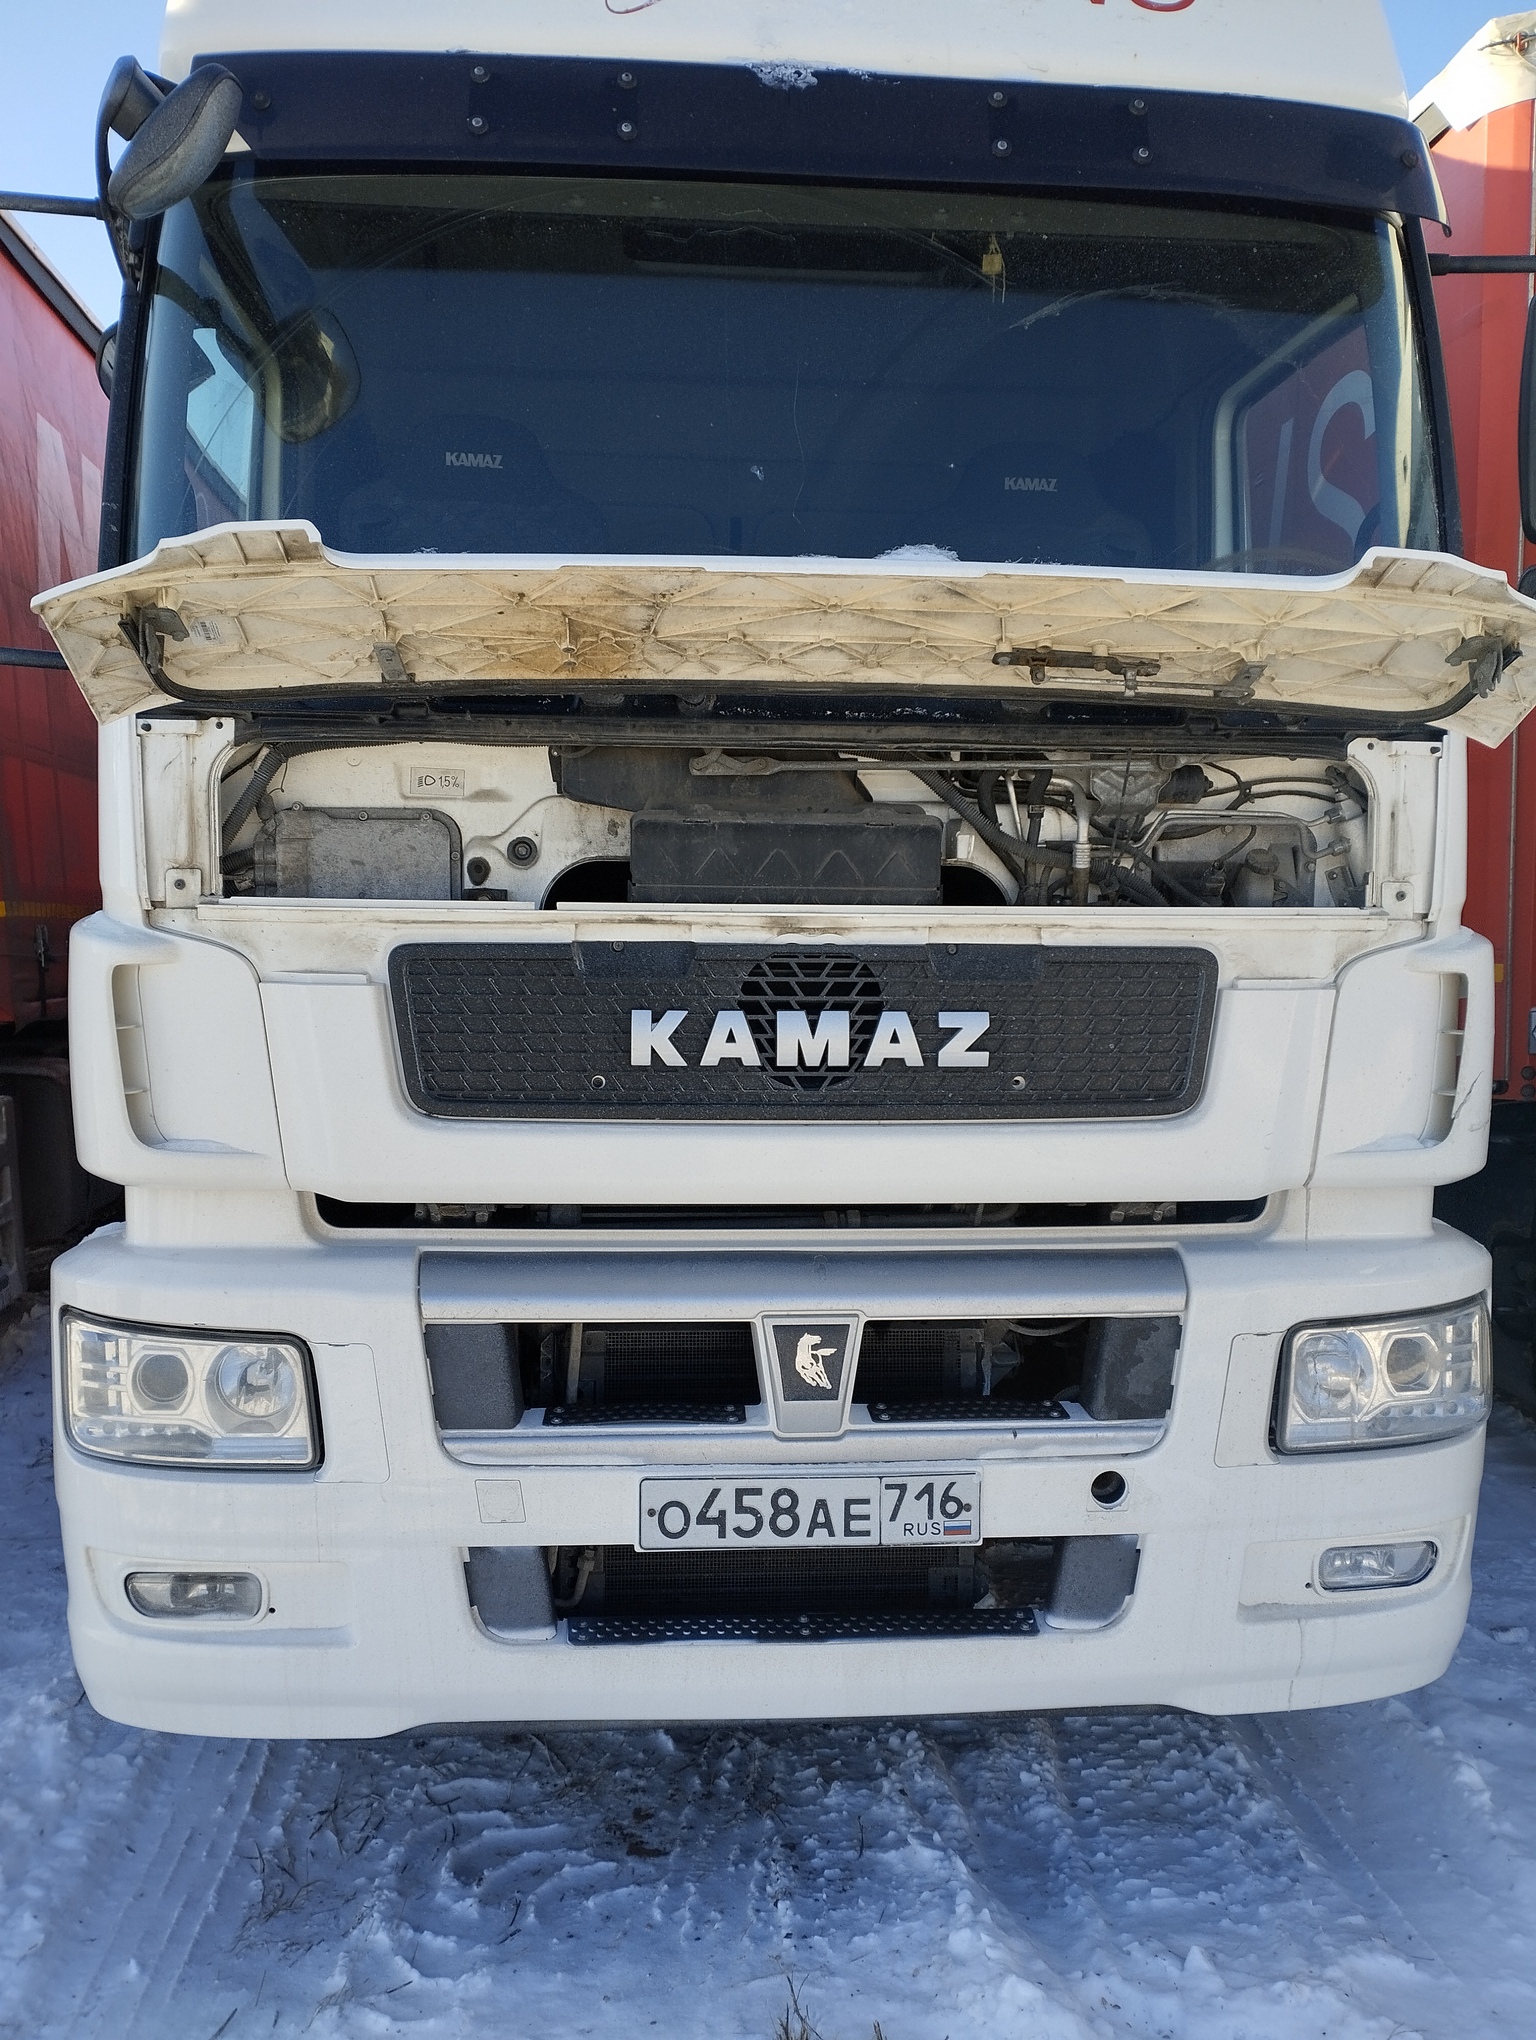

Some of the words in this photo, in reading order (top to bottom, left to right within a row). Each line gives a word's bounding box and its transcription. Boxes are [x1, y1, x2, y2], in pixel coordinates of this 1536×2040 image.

[445, 451, 504, 469] KAMAZ
[1004, 476, 1058, 492] KAMAZ
[630, 1009, 991, 1067] KAMAZ
[884, 1481, 964, 1523] 716
[903, 1521, 942, 1537] RUS
